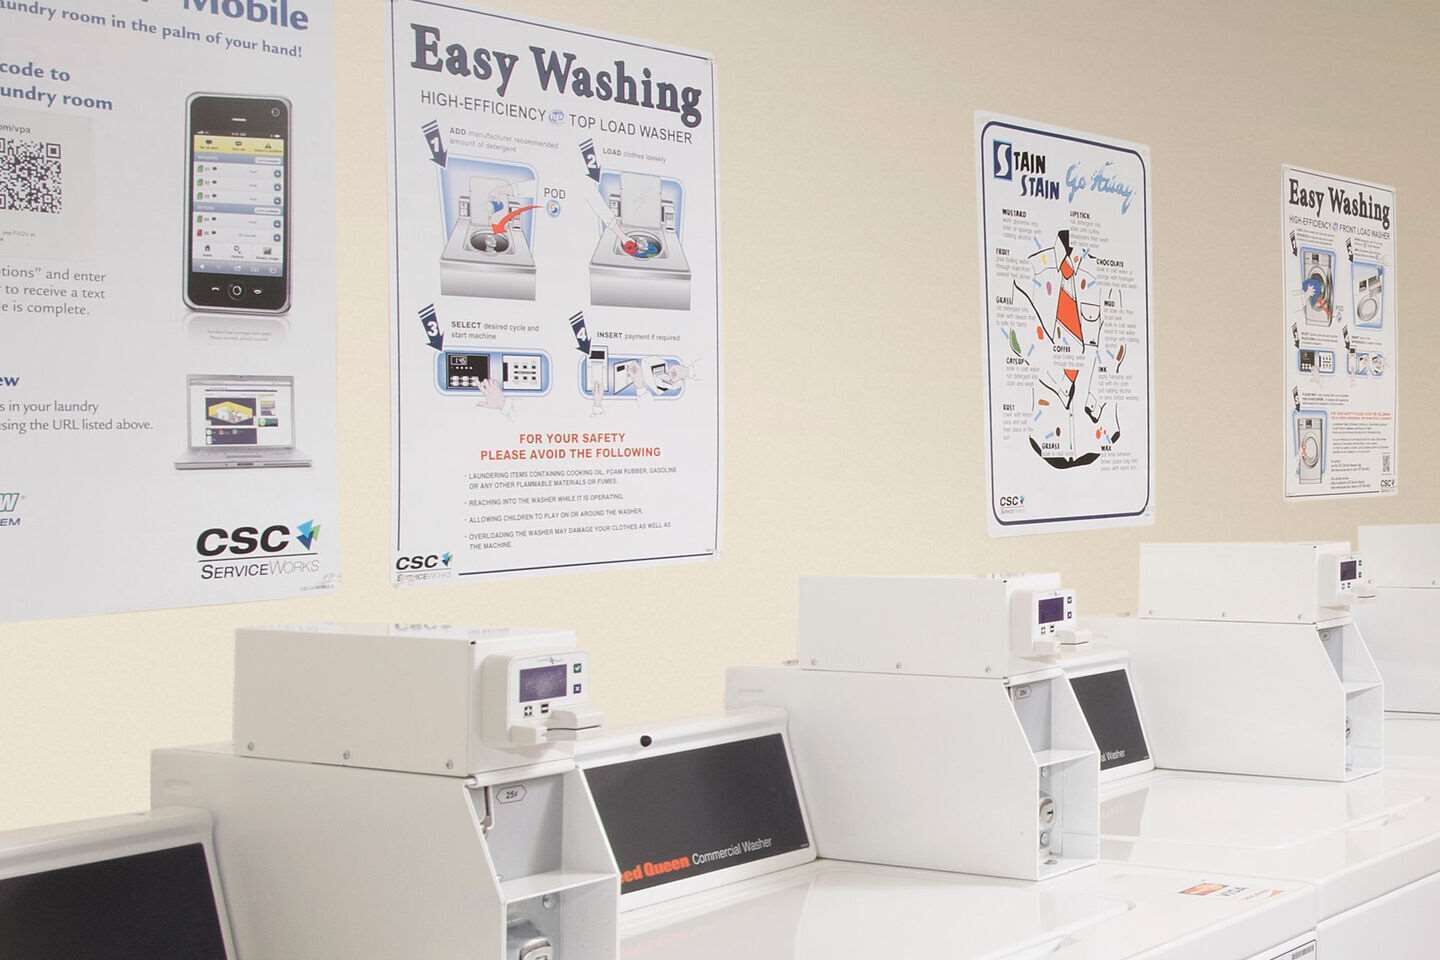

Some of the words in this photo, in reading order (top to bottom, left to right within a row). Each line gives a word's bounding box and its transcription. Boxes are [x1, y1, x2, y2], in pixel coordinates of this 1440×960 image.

[61, 9, 107, 26] room
[111, 14, 126, 29] in
[131, 19, 158, 34] the
[162, 26, 201, 41] palm
[205, 32, 223, 44] of
[225, 37, 258, 50] your
[262, 40, 303, 58] hand!
[50, 68, 71, 82] to
[410, 23, 519, 98] Easy
[529, 45, 703, 129] Washing
[62, 94, 113, 111] room
[420, 90, 547, 122] HIGH-EFFICIENCY
[569, 114, 596, 128] TOP
[600, 119, 636, 136] LOAD
[640, 125, 693, 144] WASHER
[449, 127, 466, 136] ADD
[430, 137, 440, 153] 1
[602, 147, 622, 157] LOAD
[586, 154, 597, 169] 2
[995, 143, 1046, 177] STAIN
[544, 187, 566, 199] POD
[1021, 175, 1060, 200] STAIN
[1289, 178, 1324, 217] Easy
[1328, 187, 1390, 230] Washing
[46, 268, 70, 281] and
[74, 272, 107, 282] enter
[6, 285, 20, 295] to
[24, 285, 68, 297] receive
[71, 289, 78, 298] a
[82, 289, 105, 299] text
[13, 299, 23, 312] is
[27, 302, 91, 318] complete.
[427, 321, 438, 337] 3
[451, 320, 481, 329] SELECT
[577, 326, 587, 341] 4
[597, 331, 623, 339] INSERT
[8, 401, 21, 412] in
[24, 403, 52, 415] your
[54, 400, 100, 415] laundry
[30, 418, 49, 430] the
[53, 419, 80, 430] URL
[82, 418, 113, 430] listed
[116, 419, 153, 430] above.
[519, 433, 543, 444] FOR
[546, 433, 579, 444] YOUR
[582, 432, 626, 443] SAFETY
[480, 449, 527, 461] PLEASE
[530, 448, 567, 460] AVOID
[570, 448, 592, 459] THE
[595, 447, 661, 458] FOLLOWING
[1000, 496, 1019, 506] CSC
[197, 525, 290, 557] CSC
[396, 555, 438, 570] CSC
[644, 855, 690, 877] Queen
[692, 844, 742, 865] Commercial
[742, 837, 773, 854] Washer
